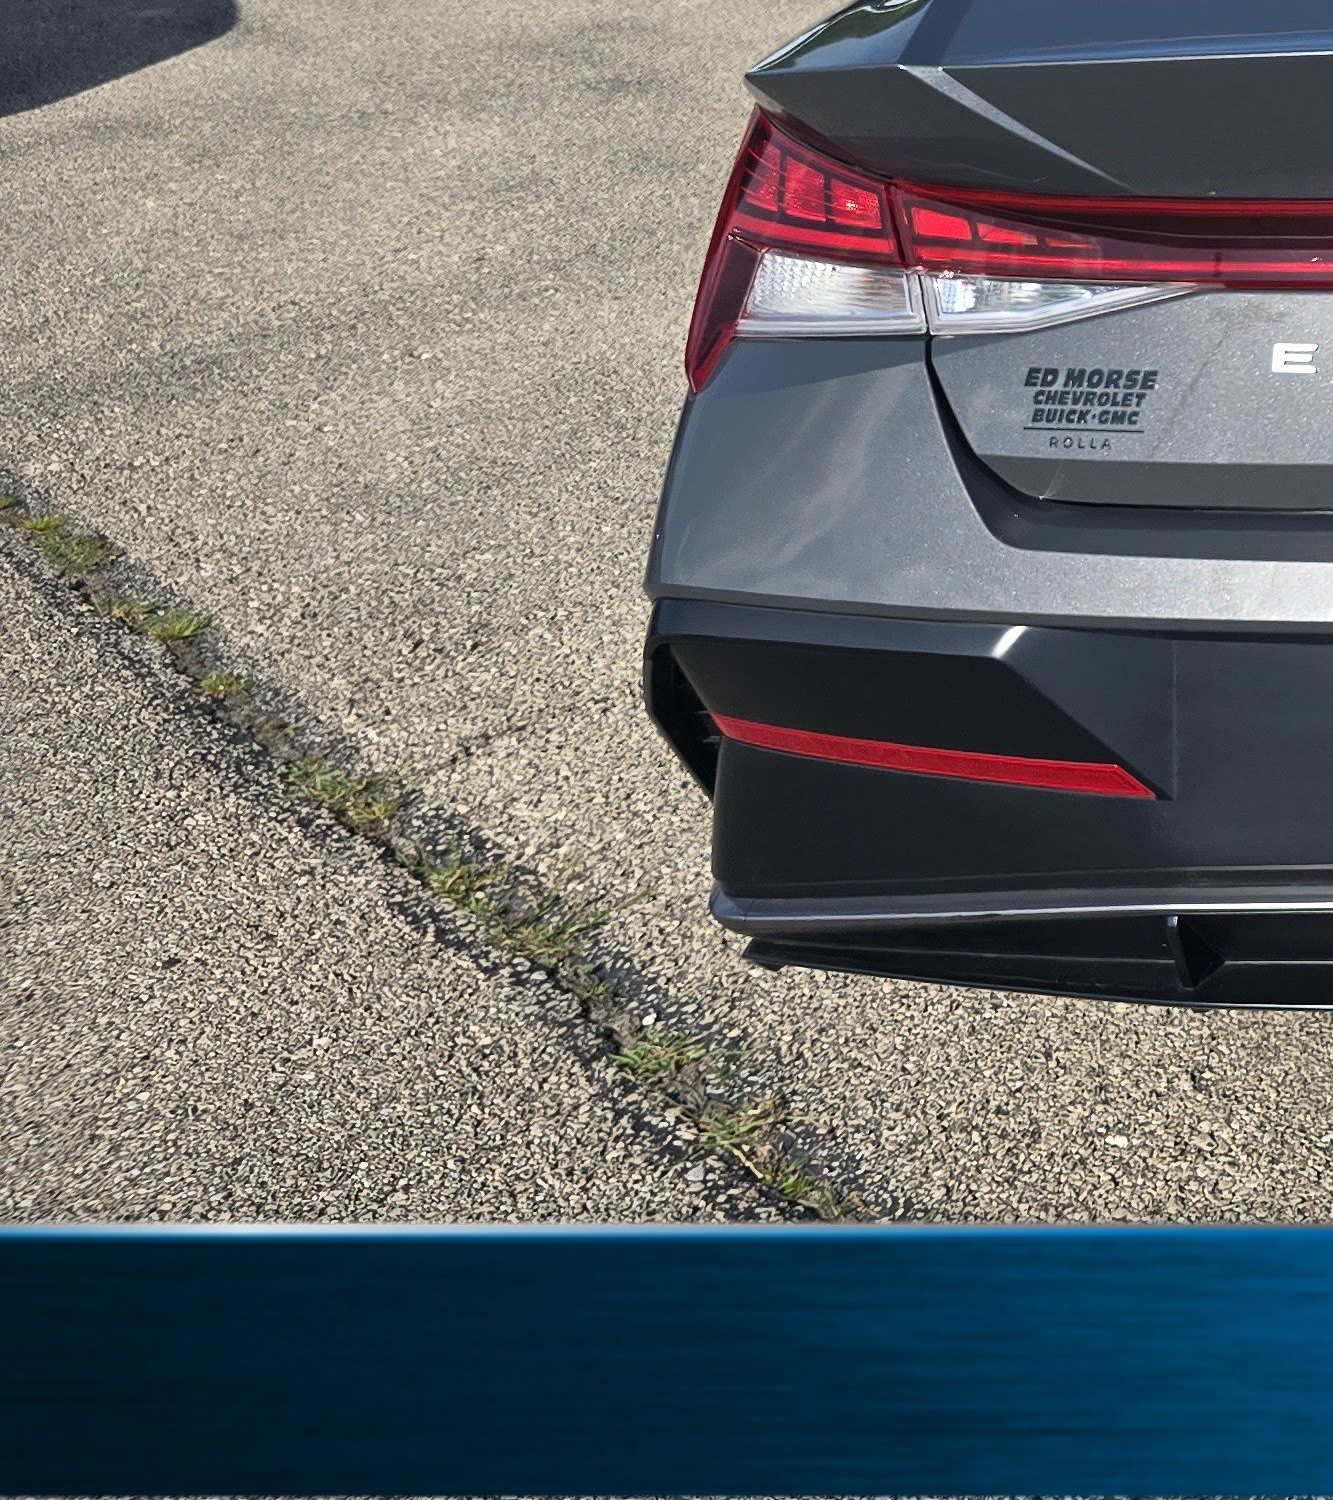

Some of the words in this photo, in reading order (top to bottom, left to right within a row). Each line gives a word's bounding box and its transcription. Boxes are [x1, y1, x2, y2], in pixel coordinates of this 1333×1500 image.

[1024, 366, 1059, 388] ED
[1063, 367, 1158, 390] MORSE
[1033, 389, 1147, 408] CHEVROLET
[1049, 436, 1111, 450] ROLLA
